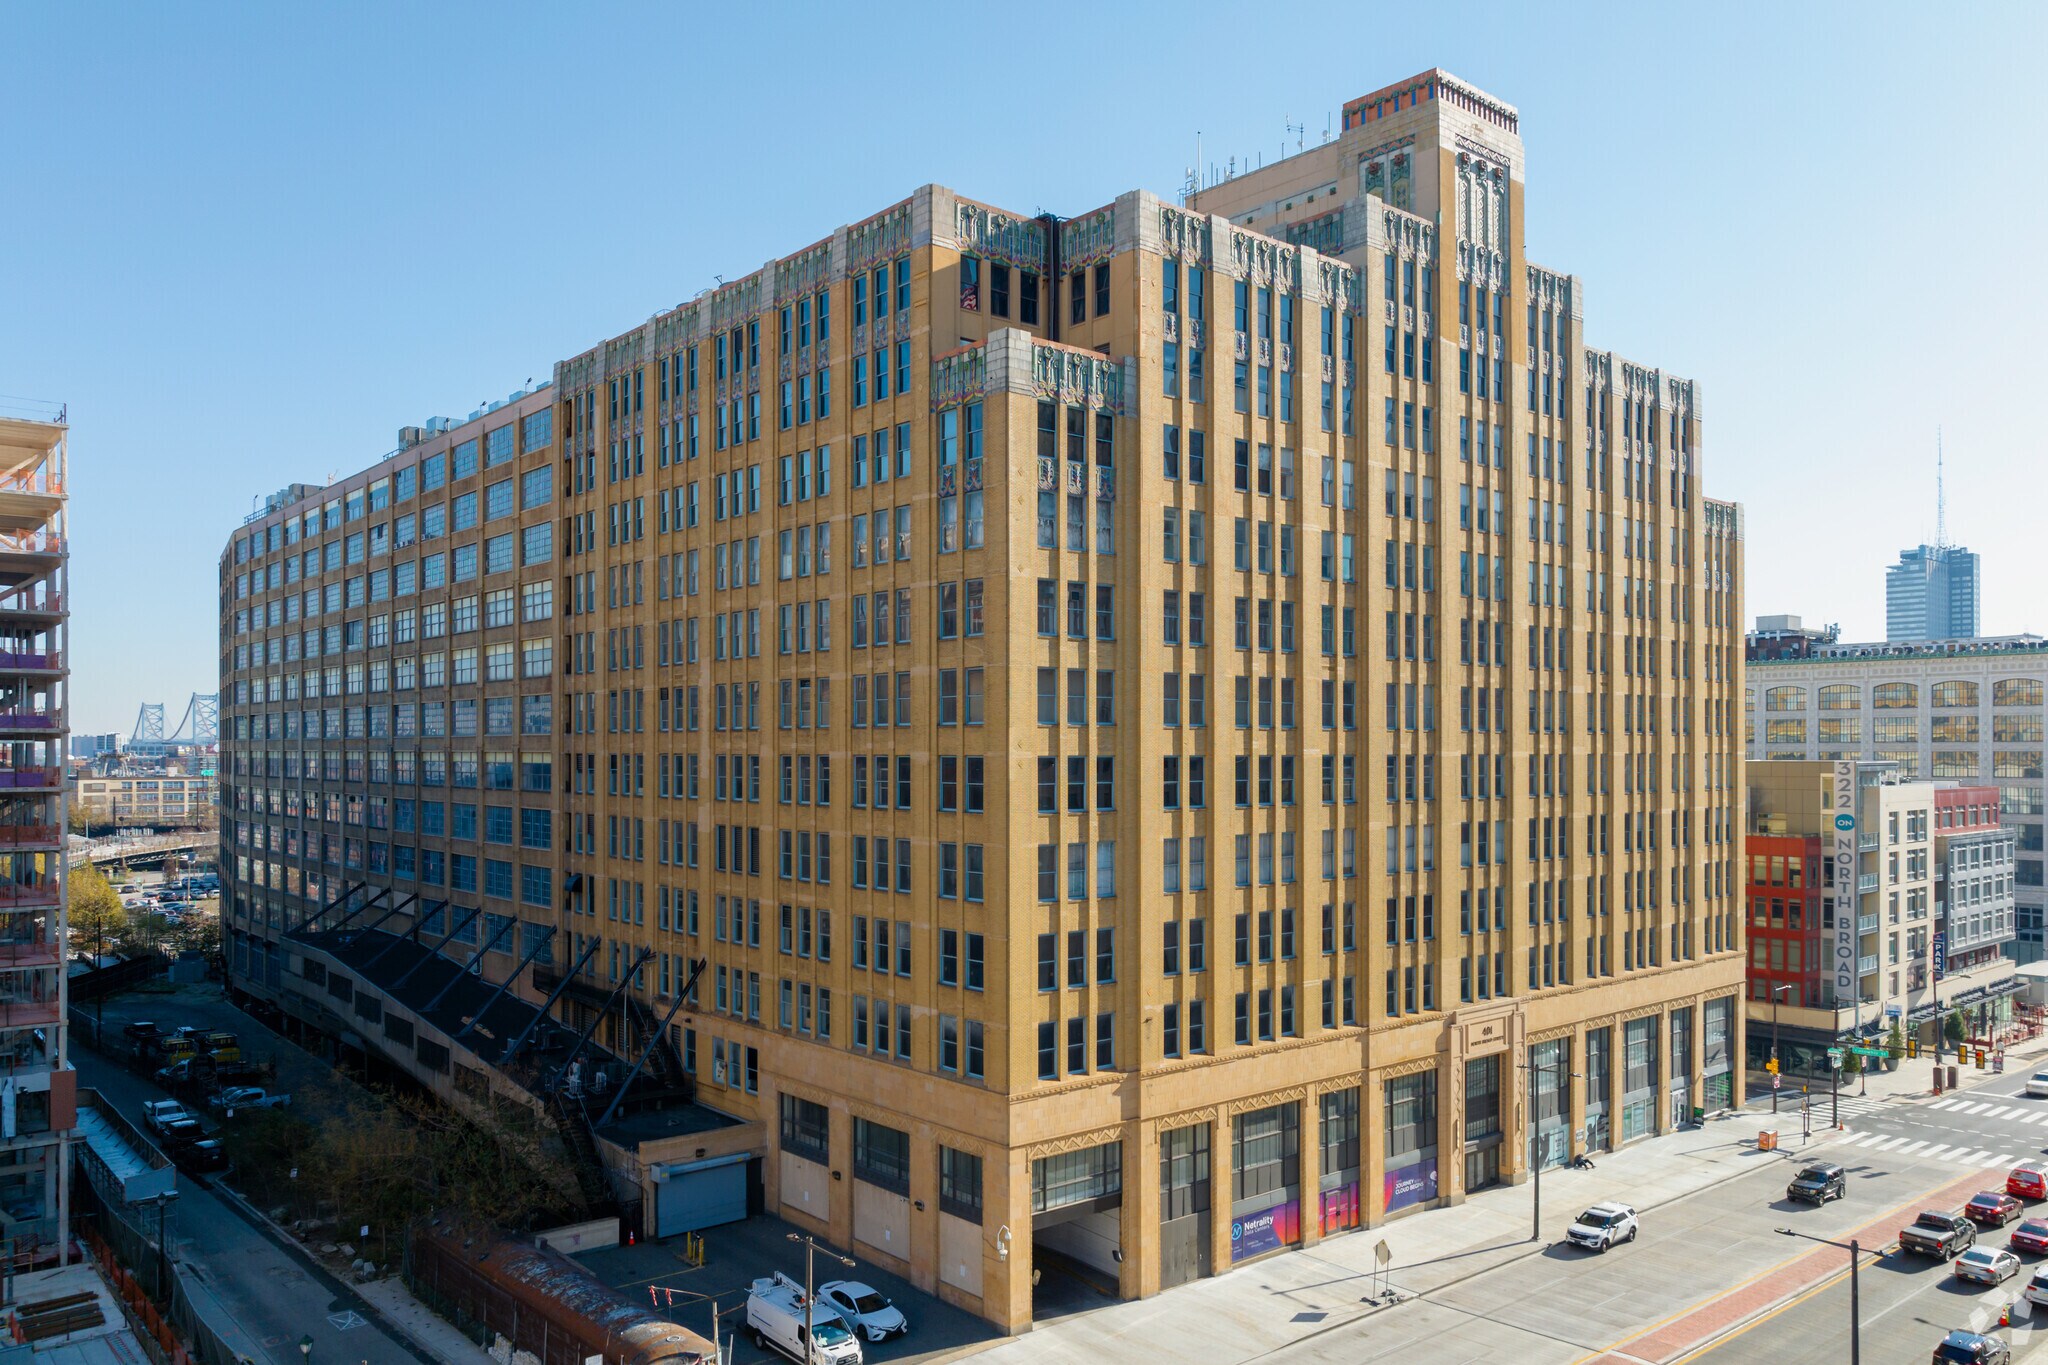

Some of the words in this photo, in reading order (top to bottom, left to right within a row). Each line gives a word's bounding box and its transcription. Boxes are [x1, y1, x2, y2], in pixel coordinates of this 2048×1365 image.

[1838, 762, 1852, 808] 322
[1837, 819, 1853, 827] ON
[1837, 838, 1852, 908] NORTH
[1837, 917, 1852, 987] BROAD
[1482, 1025, 1493, 1036] 401
[1395, 1185, 1410, 1195] CLOUD
[1244, 1216, 1274, 1231] Netrality
